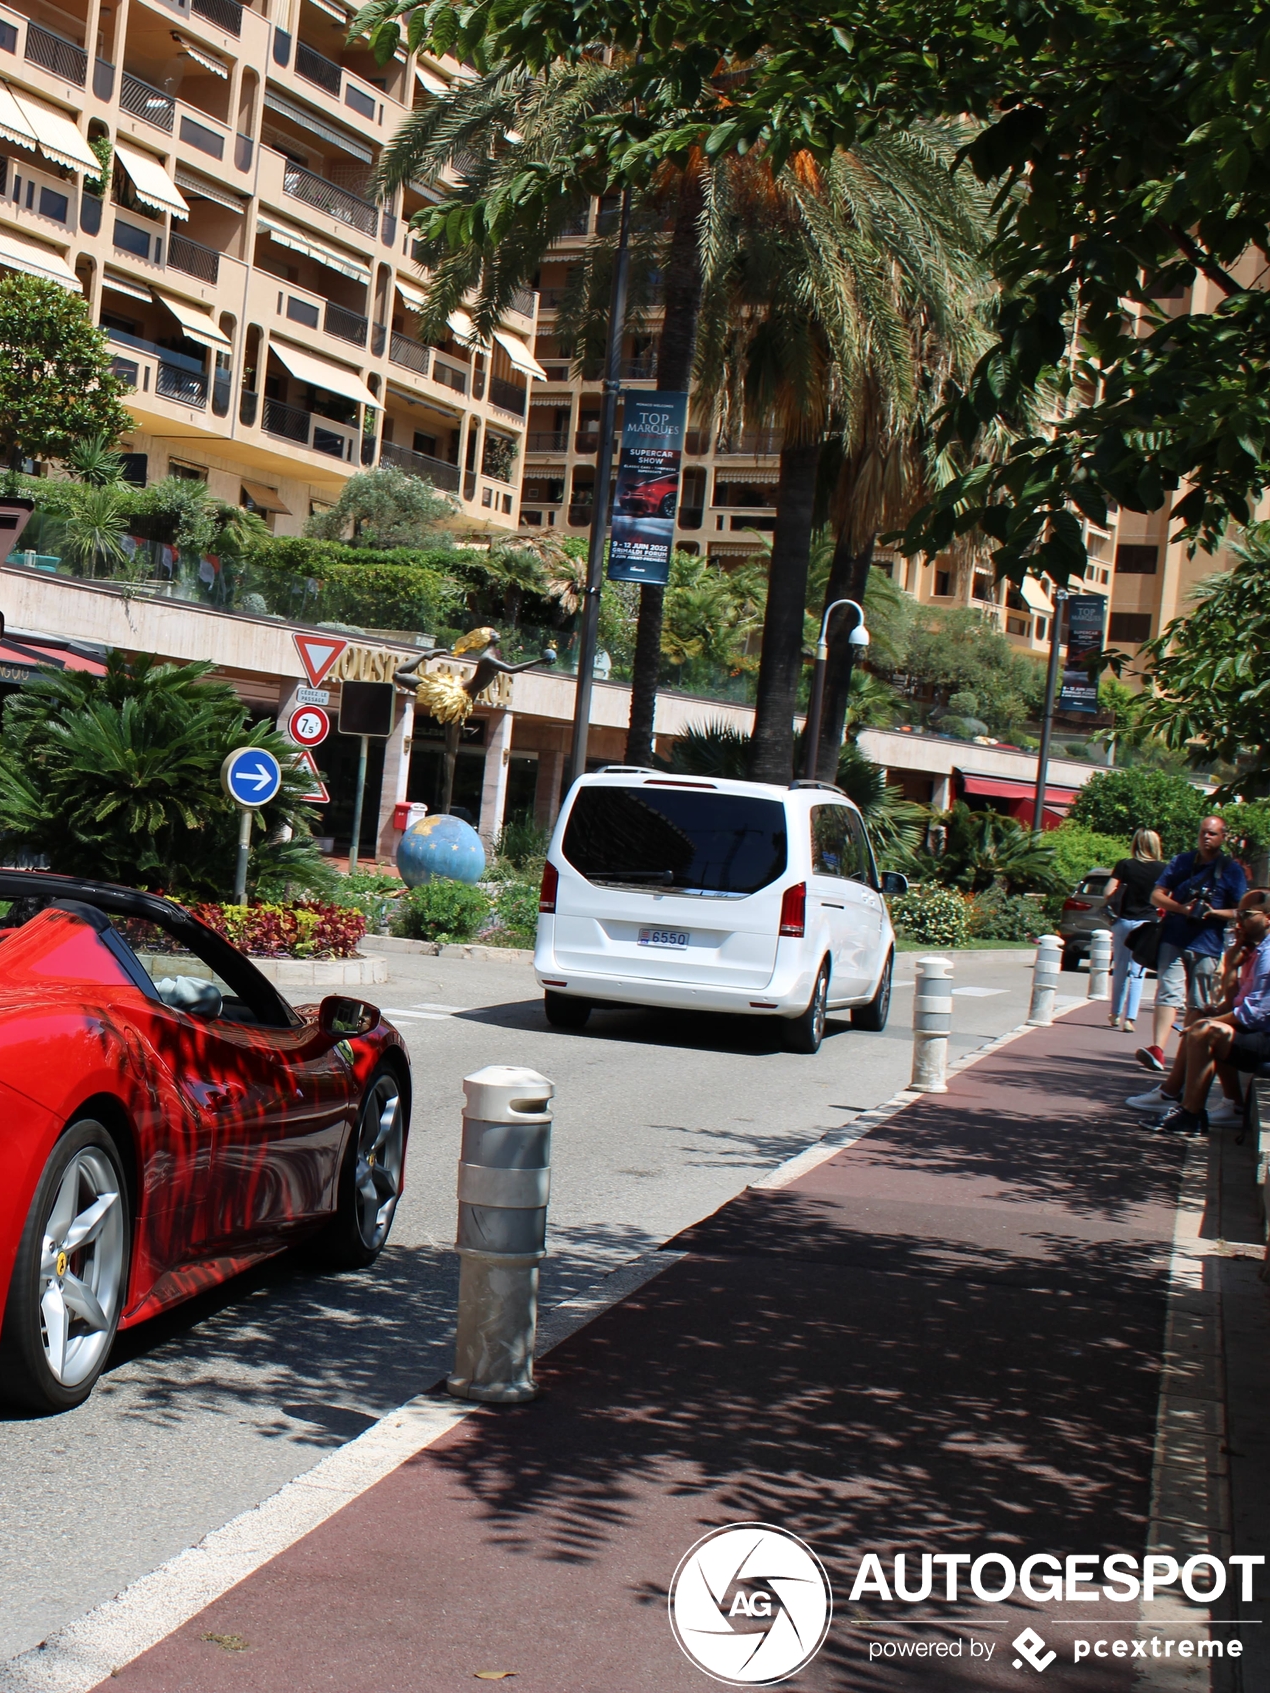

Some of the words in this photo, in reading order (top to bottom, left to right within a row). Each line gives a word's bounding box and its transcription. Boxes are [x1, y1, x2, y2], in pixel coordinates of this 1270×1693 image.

[640, 412, 670, 425] TOP
[627, 424, 680, 434] MARQUES
[630, 448, 674, 458] SUPERCAR
[638, 456, 664, 464] SHOW
[1078, 608, 1096, 616] TOP
